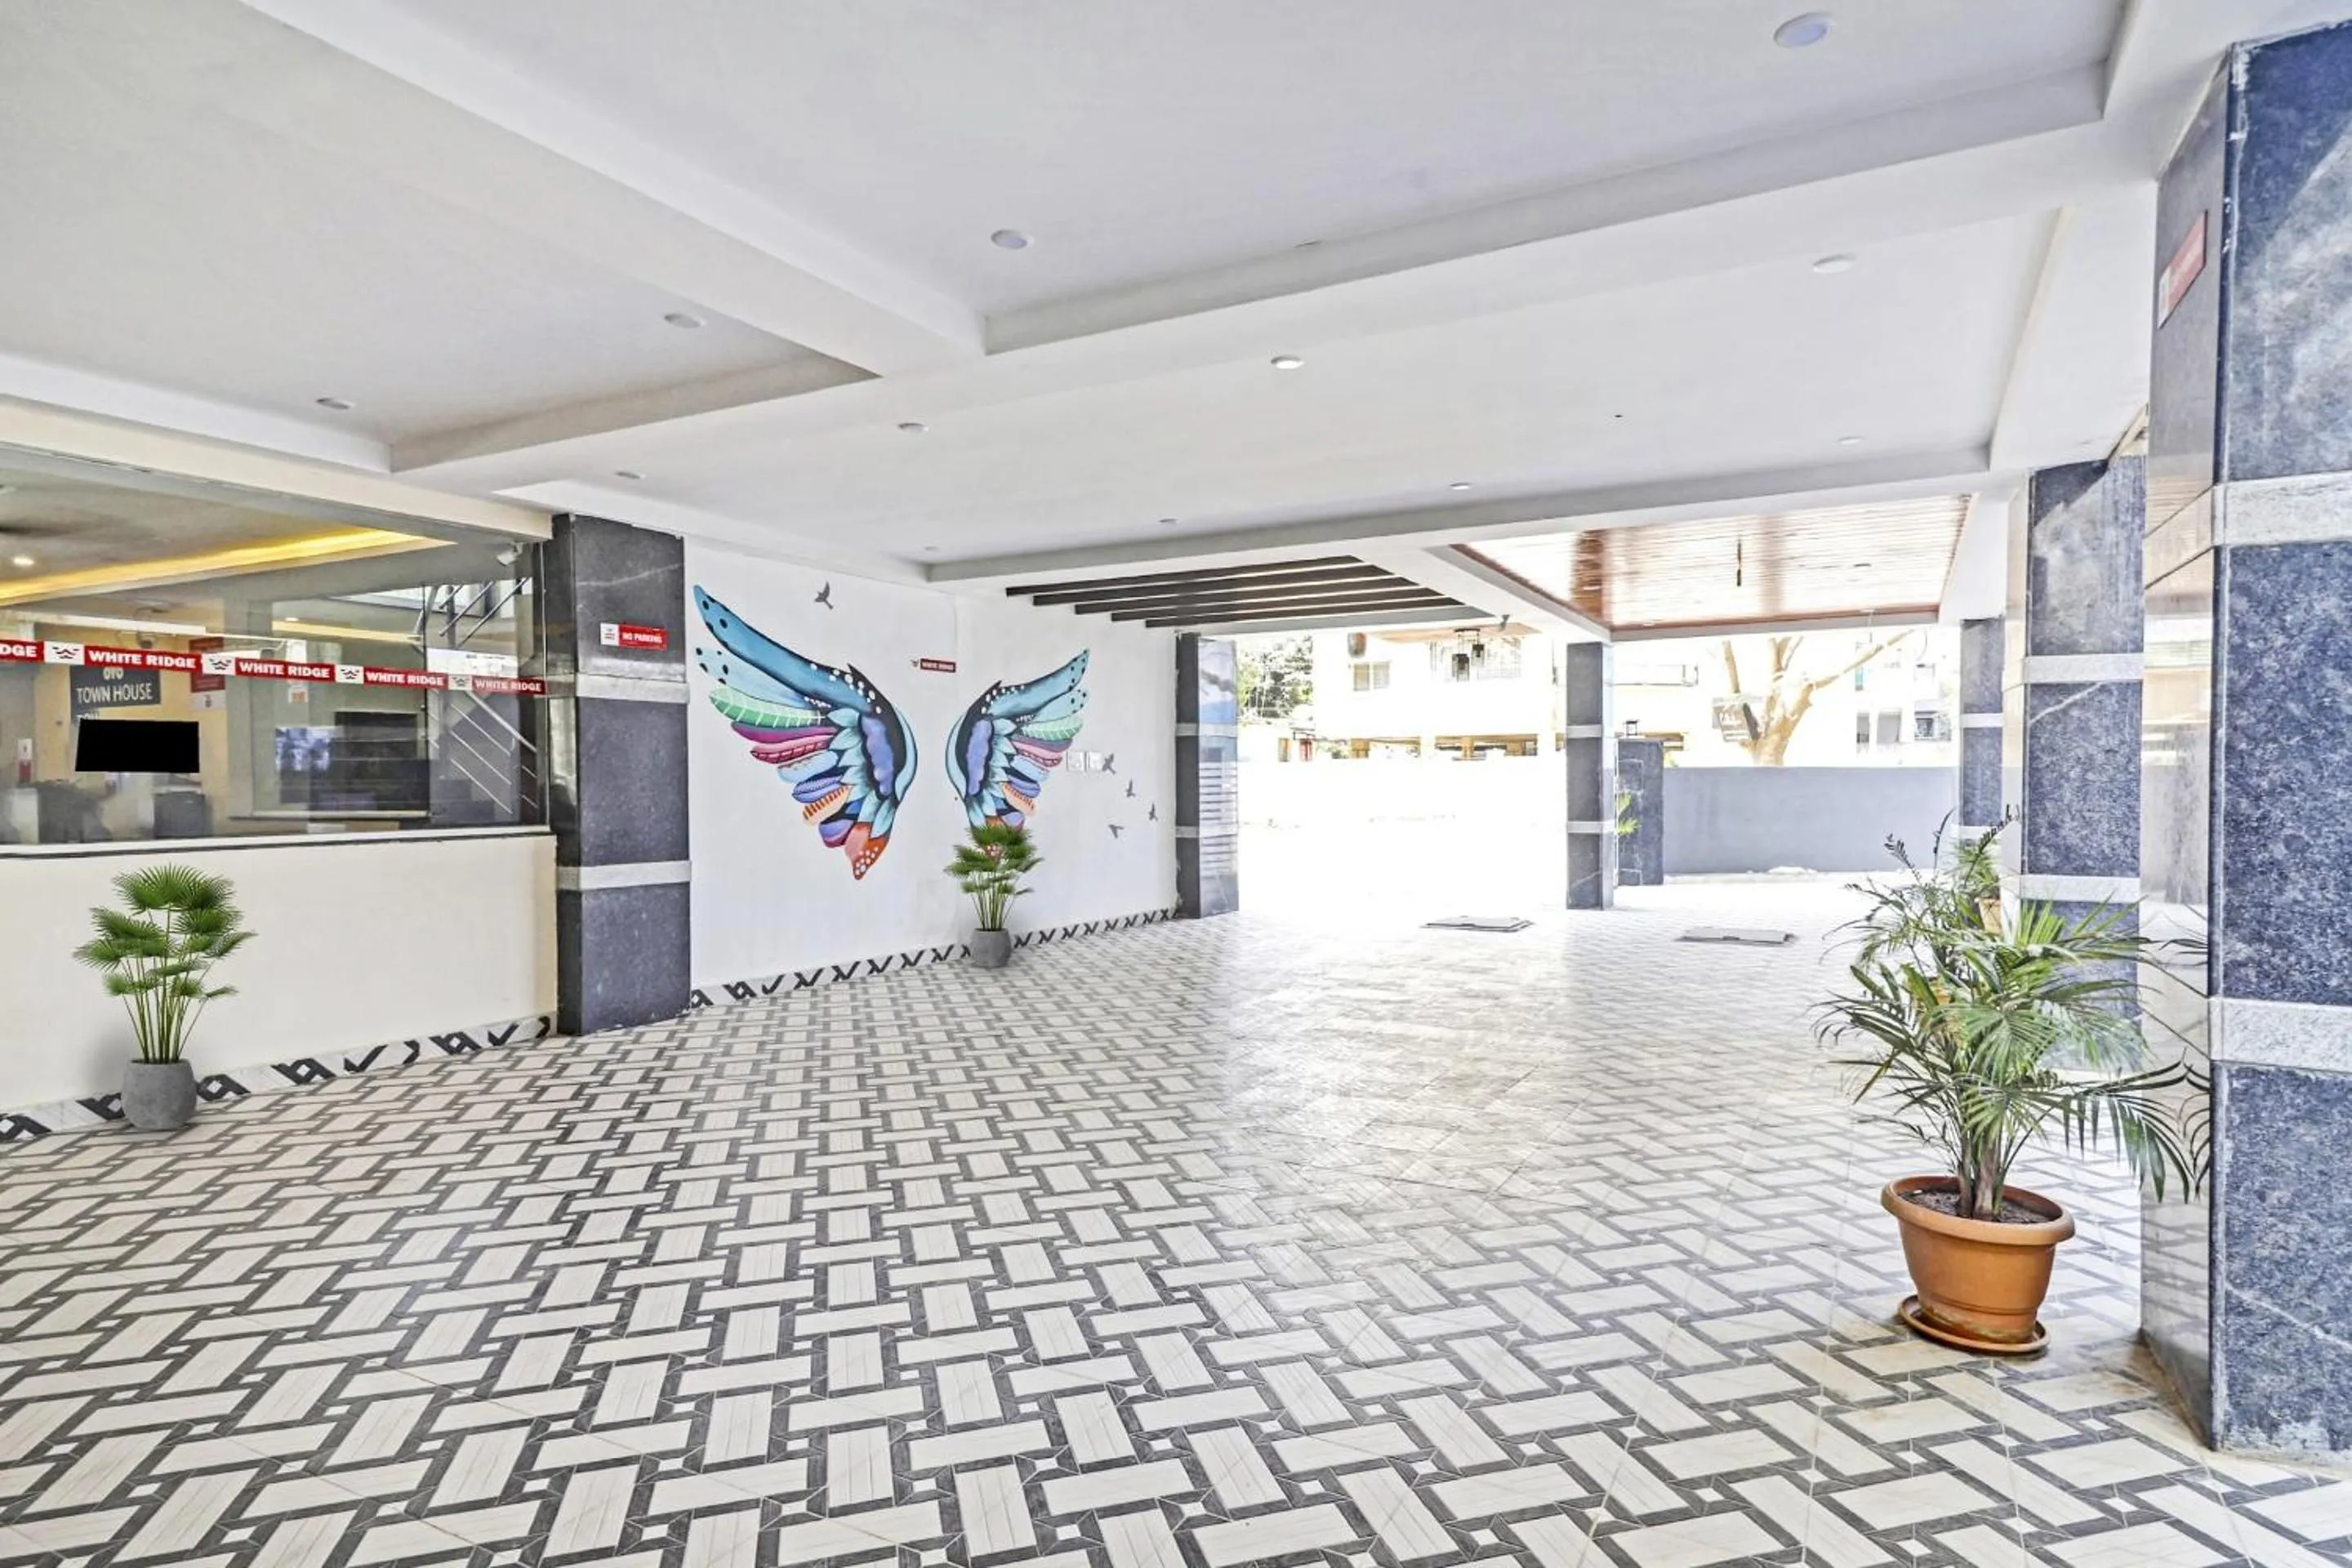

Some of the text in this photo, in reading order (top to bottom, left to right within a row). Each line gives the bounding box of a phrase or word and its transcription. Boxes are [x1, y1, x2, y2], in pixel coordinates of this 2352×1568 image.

[0, 644, 38, 657] DGE
[88, 650, 197, 669] WHITE RIDGE
[239, 662, 331, 679] WHITE RIDGE
[365, 670, 445, 686] WHITE RIDGE
[474, 679, 542, 692] WHITE RIDGE
[75, 683, 154, 705] TOWN HOUSE
